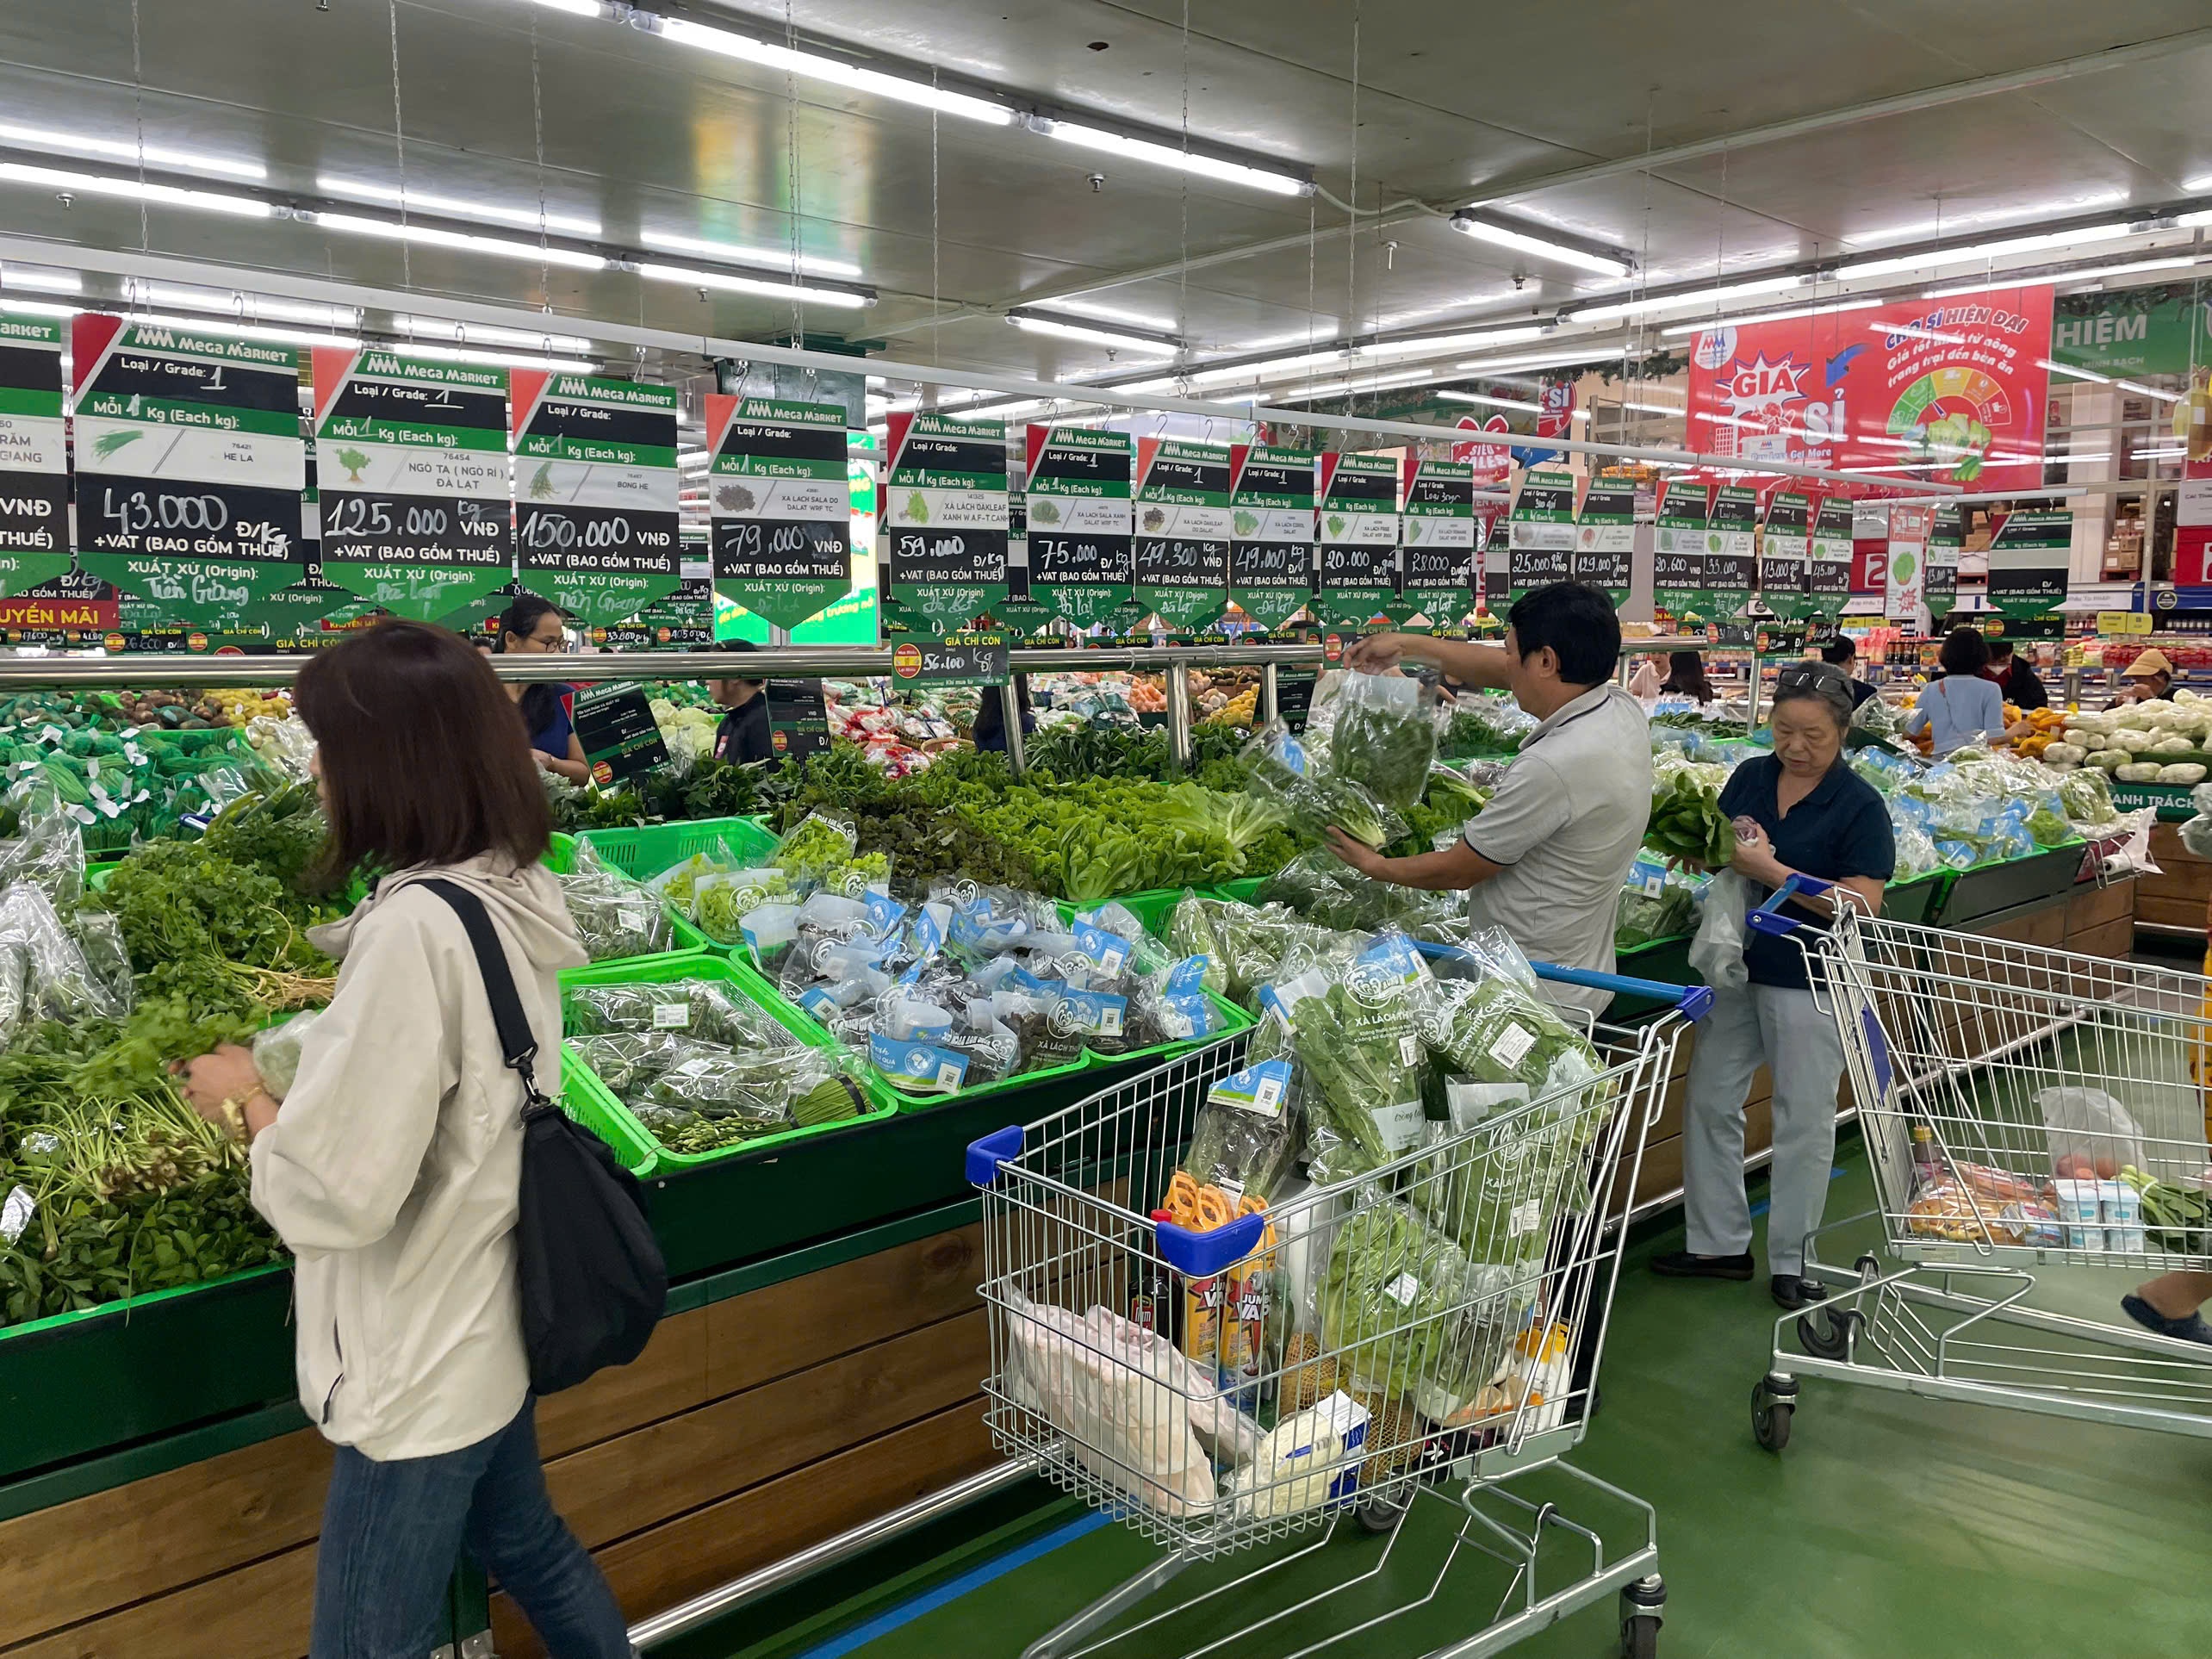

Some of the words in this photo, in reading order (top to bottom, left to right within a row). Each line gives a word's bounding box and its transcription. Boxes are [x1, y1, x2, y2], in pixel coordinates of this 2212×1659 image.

[1945, 305, 1991, 326] HIỆN
[1992, 311, 2029, 333] ĐẠI
[2056, 311, 2147, 351] HIỆM
[1887, 349, 1910, 370] Giá
[1888, 362, 1920, 388] trang
[1948, 346, 1969, 360] đến
[1998, 359, 2014, 375] ăn
[121, 357, 148, 372] Loại
[165, 363, 206, 377] Grade:
[200, 366, 227, 390] 1
[1732, 361, 1795, 398] GIÁ
[355, 384, 378, 398] Loại
[393, 388, 428, 401] Grade:
[94, 396, 121, 415] MỖI
[147, 407, 167, 424] Kg
[170, 407, 212, 426] (Each
[215, 411, 239, 428] kg):
[548, 405, 569, 417] Loại
[580, 407, 611, 419] Grade:
[1803, 388, 1846, 445] SỈ
[333, 419, 357, 437] MỖI
[379, 428, 395, 442] Kg
[399, 429, 434, 444] (Each
[437, 432, 458, 447] kg):
[529, 438, 549, 453] MỖI
[568, 445, 581, 459] Kg
[585, 447, 616, 460] (Each
[618, 449, 636, 463] kg):
[1808, 448, 1831, 458] More
[409, 460, 432, 473] NGÒ
[436, 465, 450, 475] TA
[461, 463, 483, 475] NGÒ
[437, 477, 453, 488] ĐÀ
[457, 480, 480, 491] LẠT
[0, 498, 52, 517] VNĐ
[103, 488, 227, 534] 43.000
[460, 520, 499, 537] VNĐ
[637, 531, 670, 545] VNĐ
[95, 534, 139, 550] +VAT
[146, 536, 192, 554] (BAO
[195, 536, 233, 555] GỒM
[334, 545, 373, 557] +VAT
[378, 545, 415, 561] (BAO
[419, 542, 452, 561] GỒM
[456, 544, 500, 564] THUẾ)
[814, 540, 843, 554] VNĐ
[128, 557, 172, 575] XUẤT
[177, 560, 201, 575] XỨ
[206, 564, 259, 581] (Origin):
[529, 554, 562, 565] +VAT
[566, 555, 597, 569] (BAO
[601, 551, 629, 569] GỒM
[633, 556, 671, 572] THUẾ)
[724, 563, 751, 575] +VAT
[755, 563, 781, 576] (BAO
[785, 559, 809, 575] GỒM
[811, 560, 843, 577] THUẾ)
[364, 563, 401, 579] XUẤT
[406, 567, 426, 580] XỨ
[430, 569, 475, 583] (Origin):
[554, 571, 586, 585] XUẤT
[590, 575, 606, 586] XỨ
[610, 577, 649, 590] (Origin):
[899, 569, 923, 580] +VAT
[926, 570, 948, 581] (BAO
[744, 579, 774, 593] XUẤT
[775, 581, 790, 593] XỨ
[792, 583, 825, 594] (Origin):
[60, 606, 98, 624] MÃI
[945, 635, 960, 646] GIÁ
[964, 634, 979, 646] CHỈ
[981, 635, 1000, 645] CÒN
